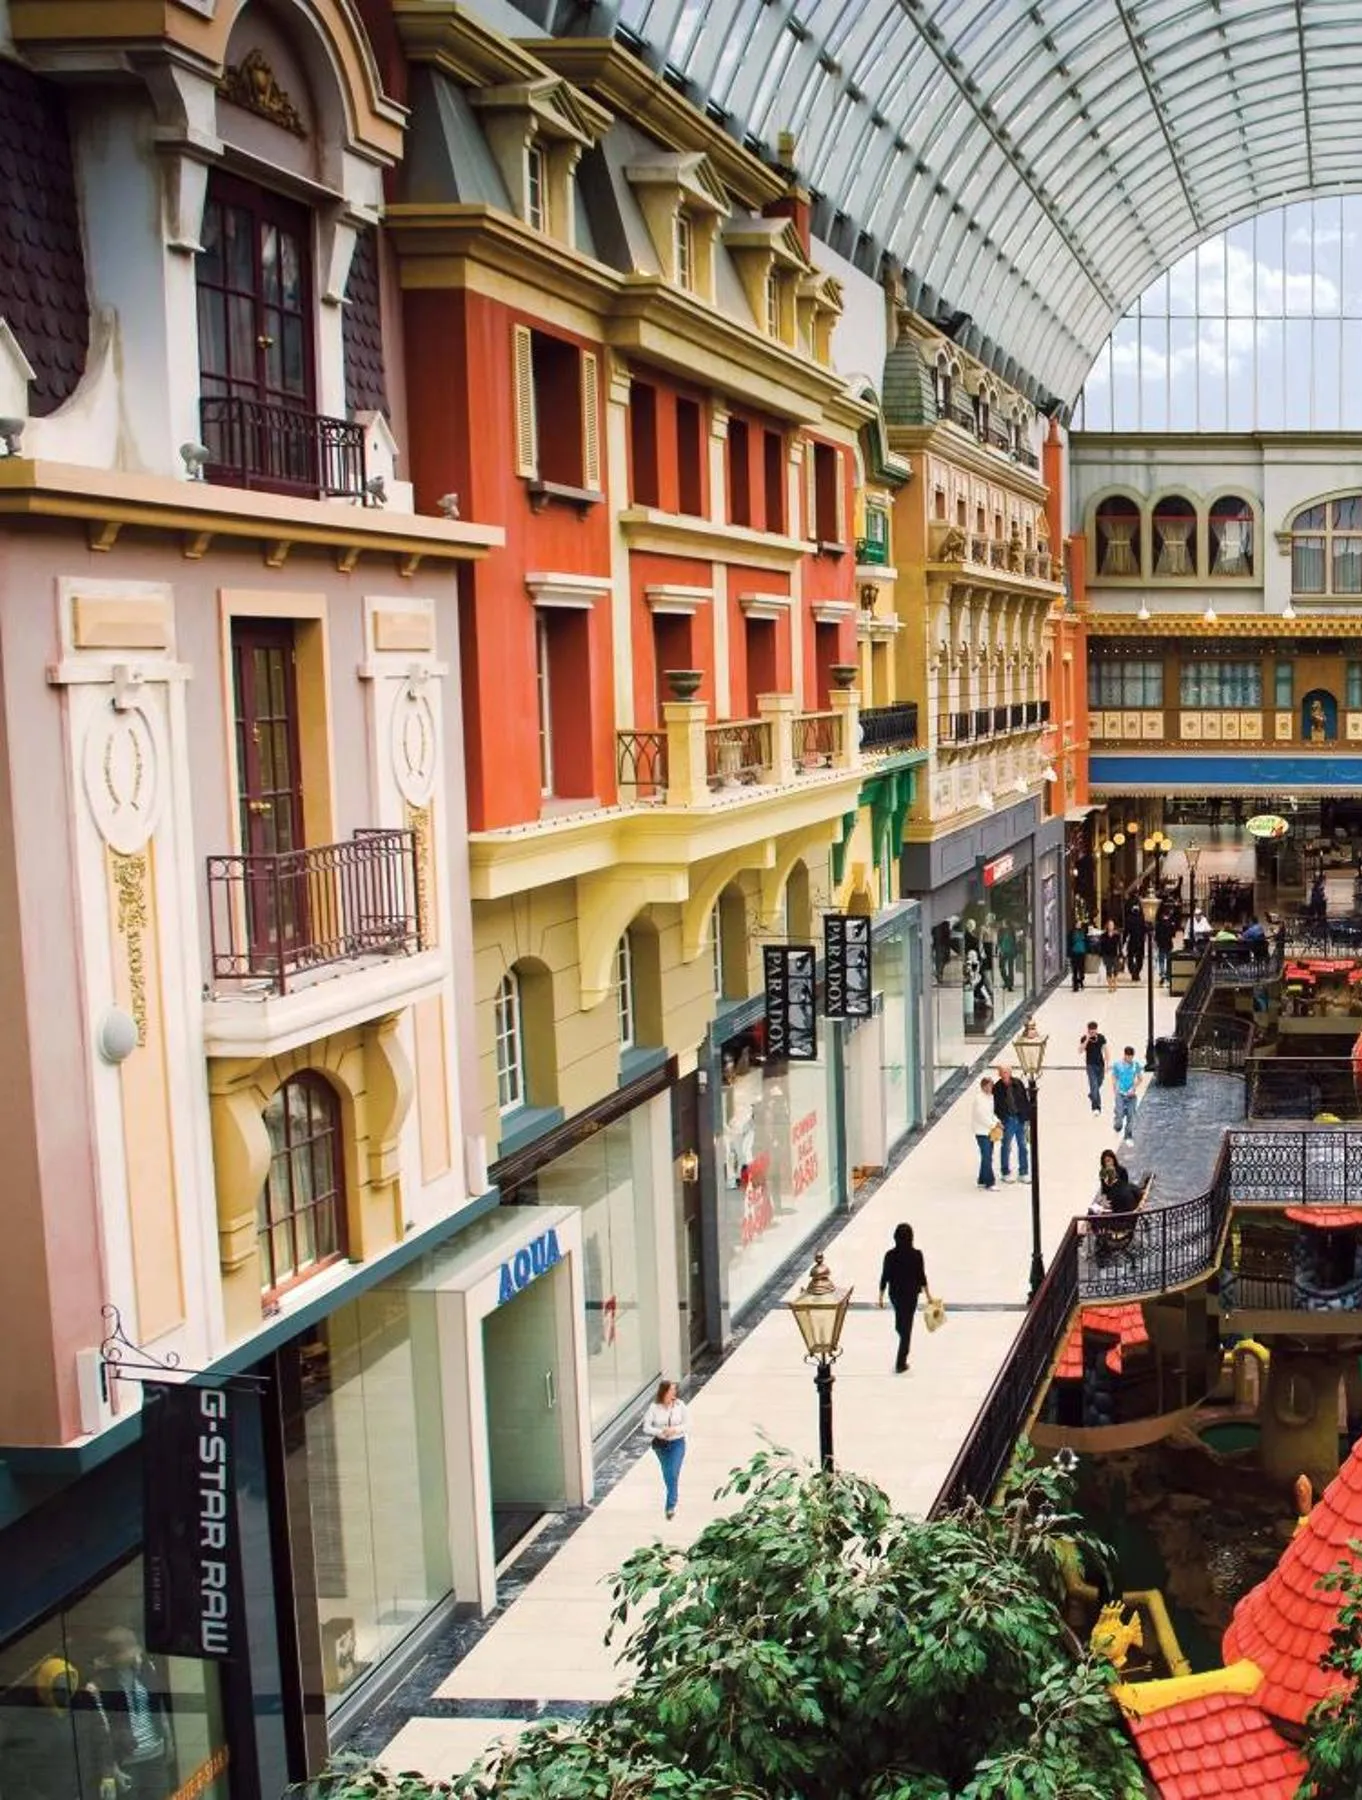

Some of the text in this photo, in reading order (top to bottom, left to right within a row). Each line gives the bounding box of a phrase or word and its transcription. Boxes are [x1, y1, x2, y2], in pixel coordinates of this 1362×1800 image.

[767, 951, 784, 1054] PARADOX
[828, 920, 842, 1013] PARADOX
[497, 1228, 563, 1307] AQUA
[200, 1389, 229, 1655] G-STAR RAW
